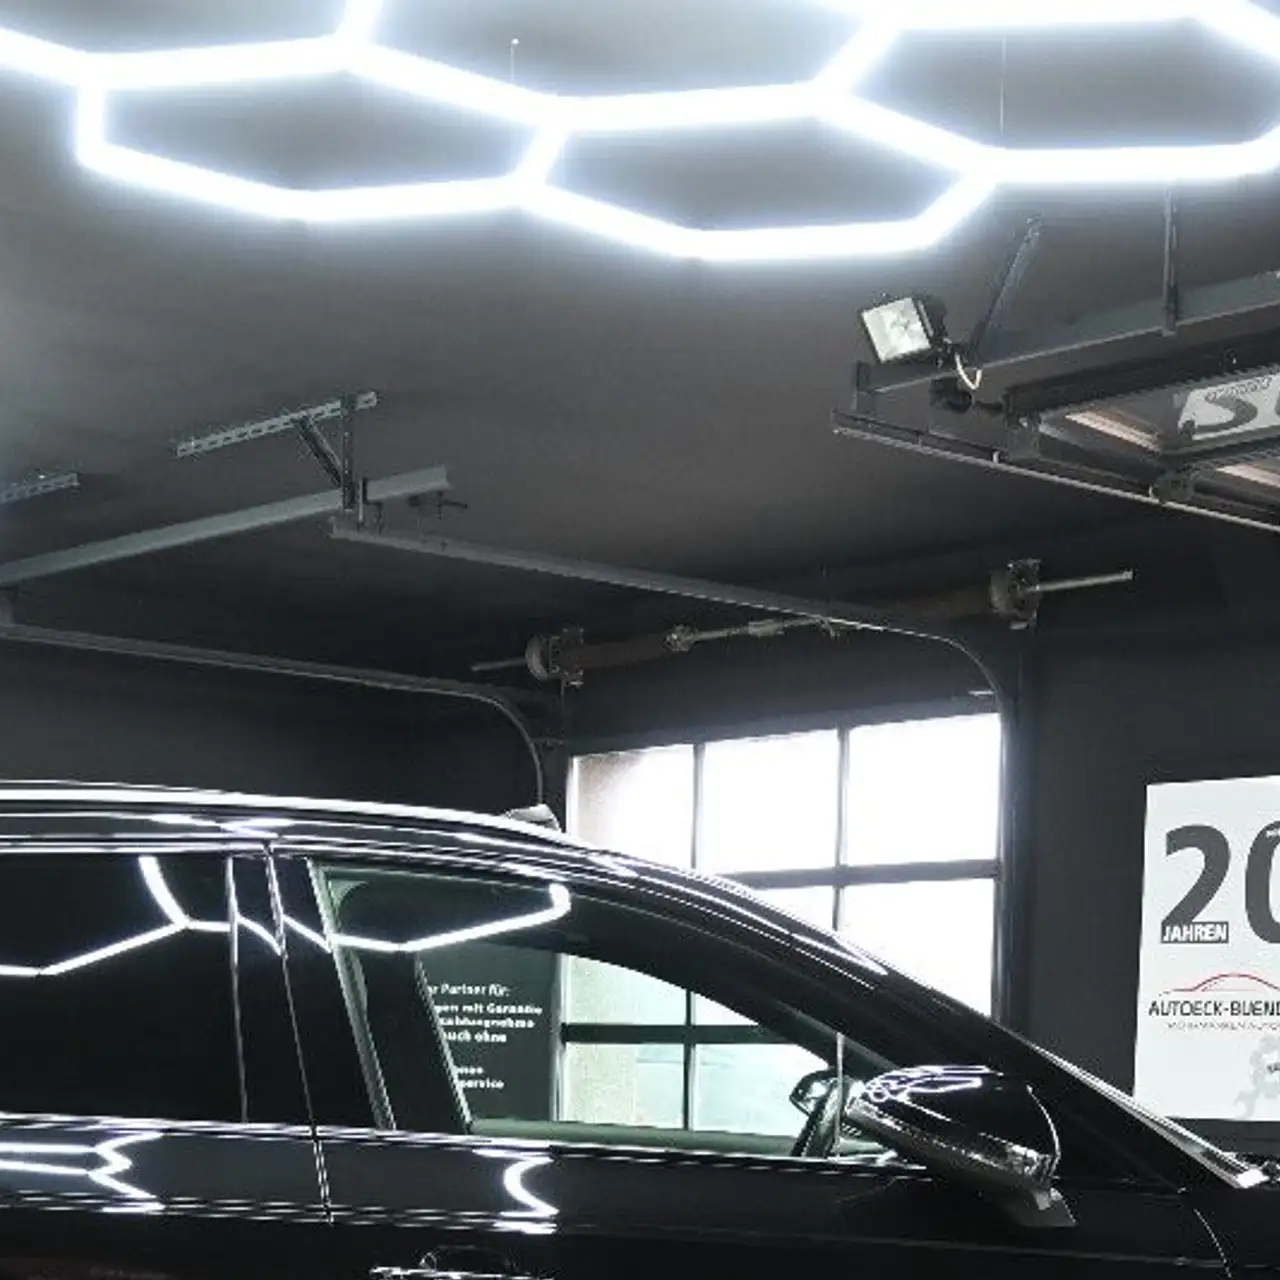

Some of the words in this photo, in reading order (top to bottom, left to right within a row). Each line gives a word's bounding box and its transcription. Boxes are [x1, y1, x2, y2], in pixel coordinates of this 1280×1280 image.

[1163, 923, 1228, 942] JAHREN
[440, 983, 486, 996] Partner
[463, 1003, 484, 1014] mit
[474, 1030, 508, 1043] ohne
